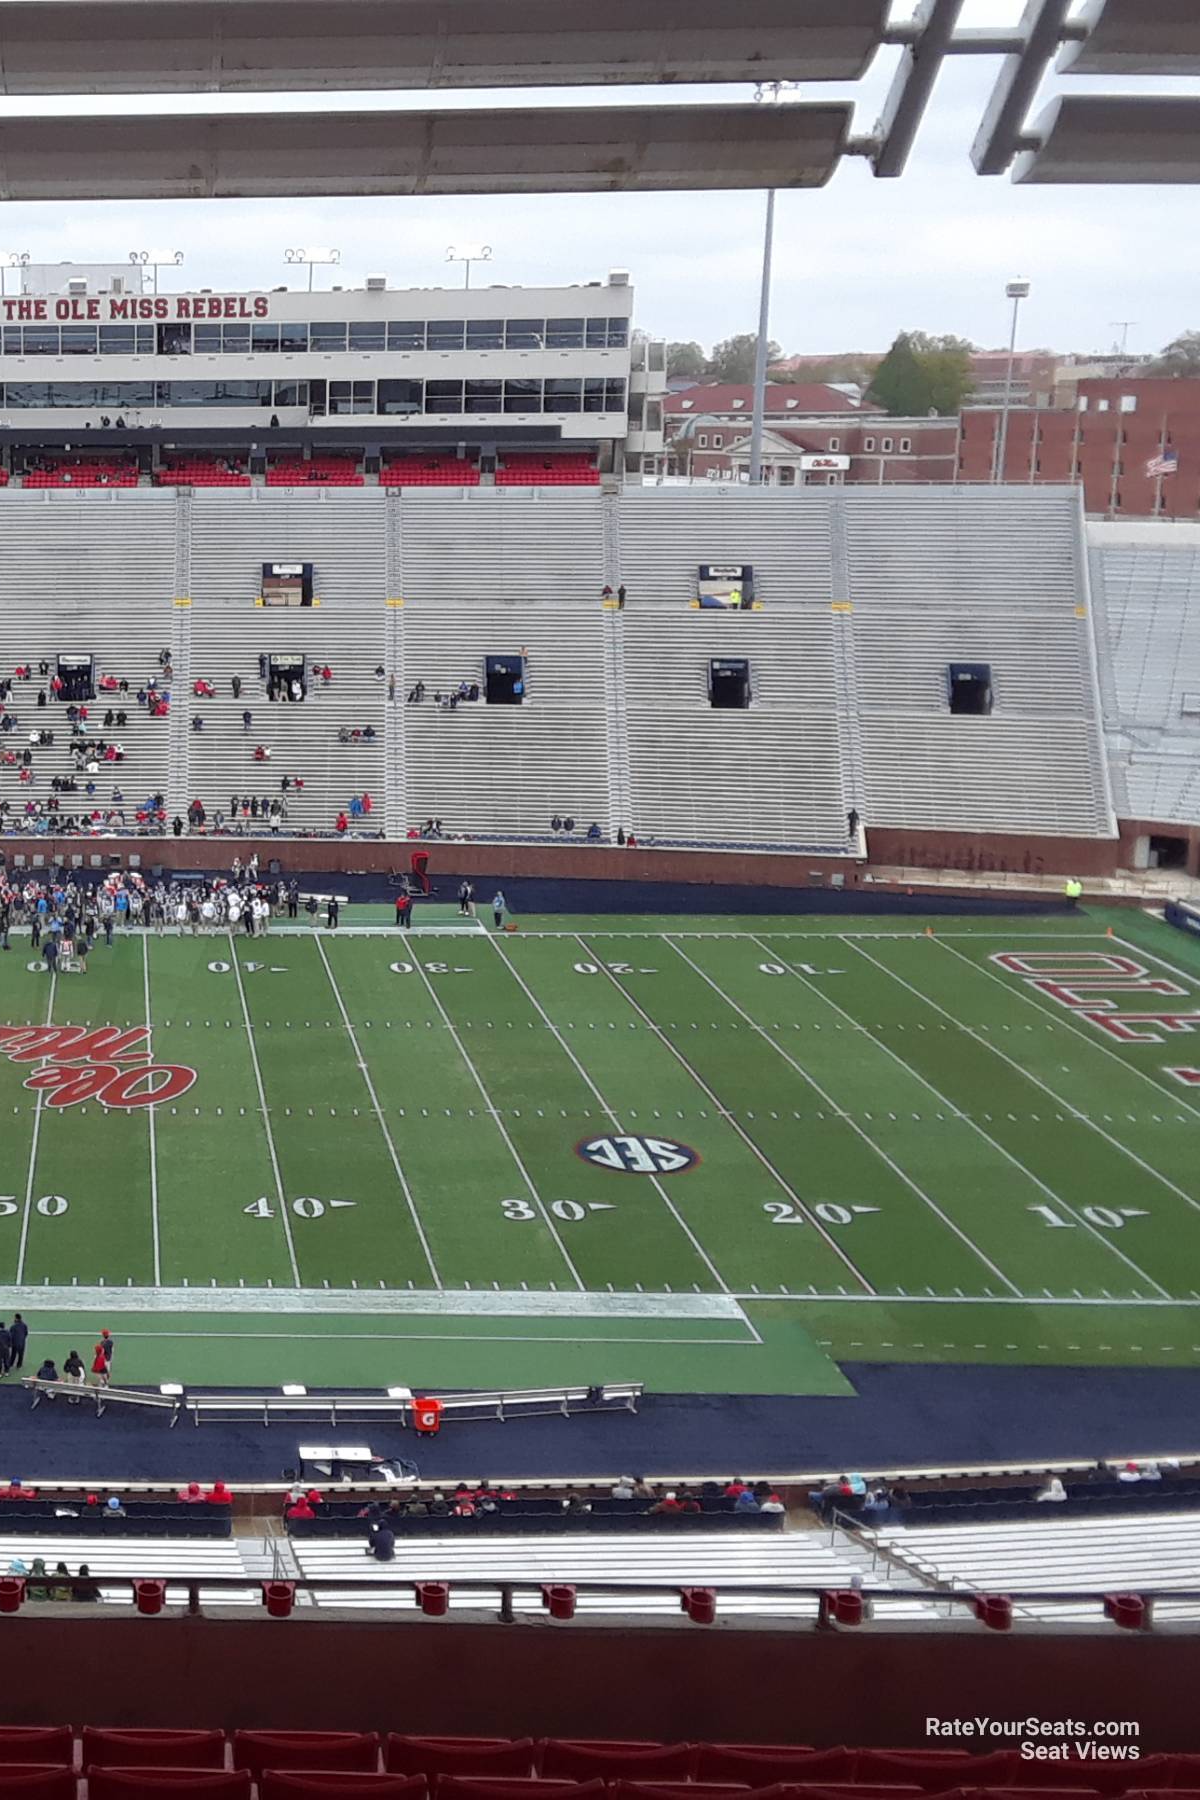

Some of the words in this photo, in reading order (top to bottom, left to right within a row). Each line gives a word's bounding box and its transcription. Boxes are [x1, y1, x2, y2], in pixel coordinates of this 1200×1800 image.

[3, 300, 48, 321] THE
[56, 299, 100, 320] OLE
[110, 299, 169, 319] MISS
[176, 297, 269, 319] REBELS
[207, 961, 266, 973] 40
[389, 962, 450, 974] 30
[573, 963, 635, 975] 20
[758, 963, 825, 976] 10
[23, 1063, 198, 1109] Ole
[586, 1136, 690, 1172] SEC
[243, 1196, 326, 1219] 40
[500, 1199, 586, 1222] 30
[763, 1202, 852, 1225] 20
[1025, 1205, 1125, 1228] 10
[422, 1412, 435, 1426] G
